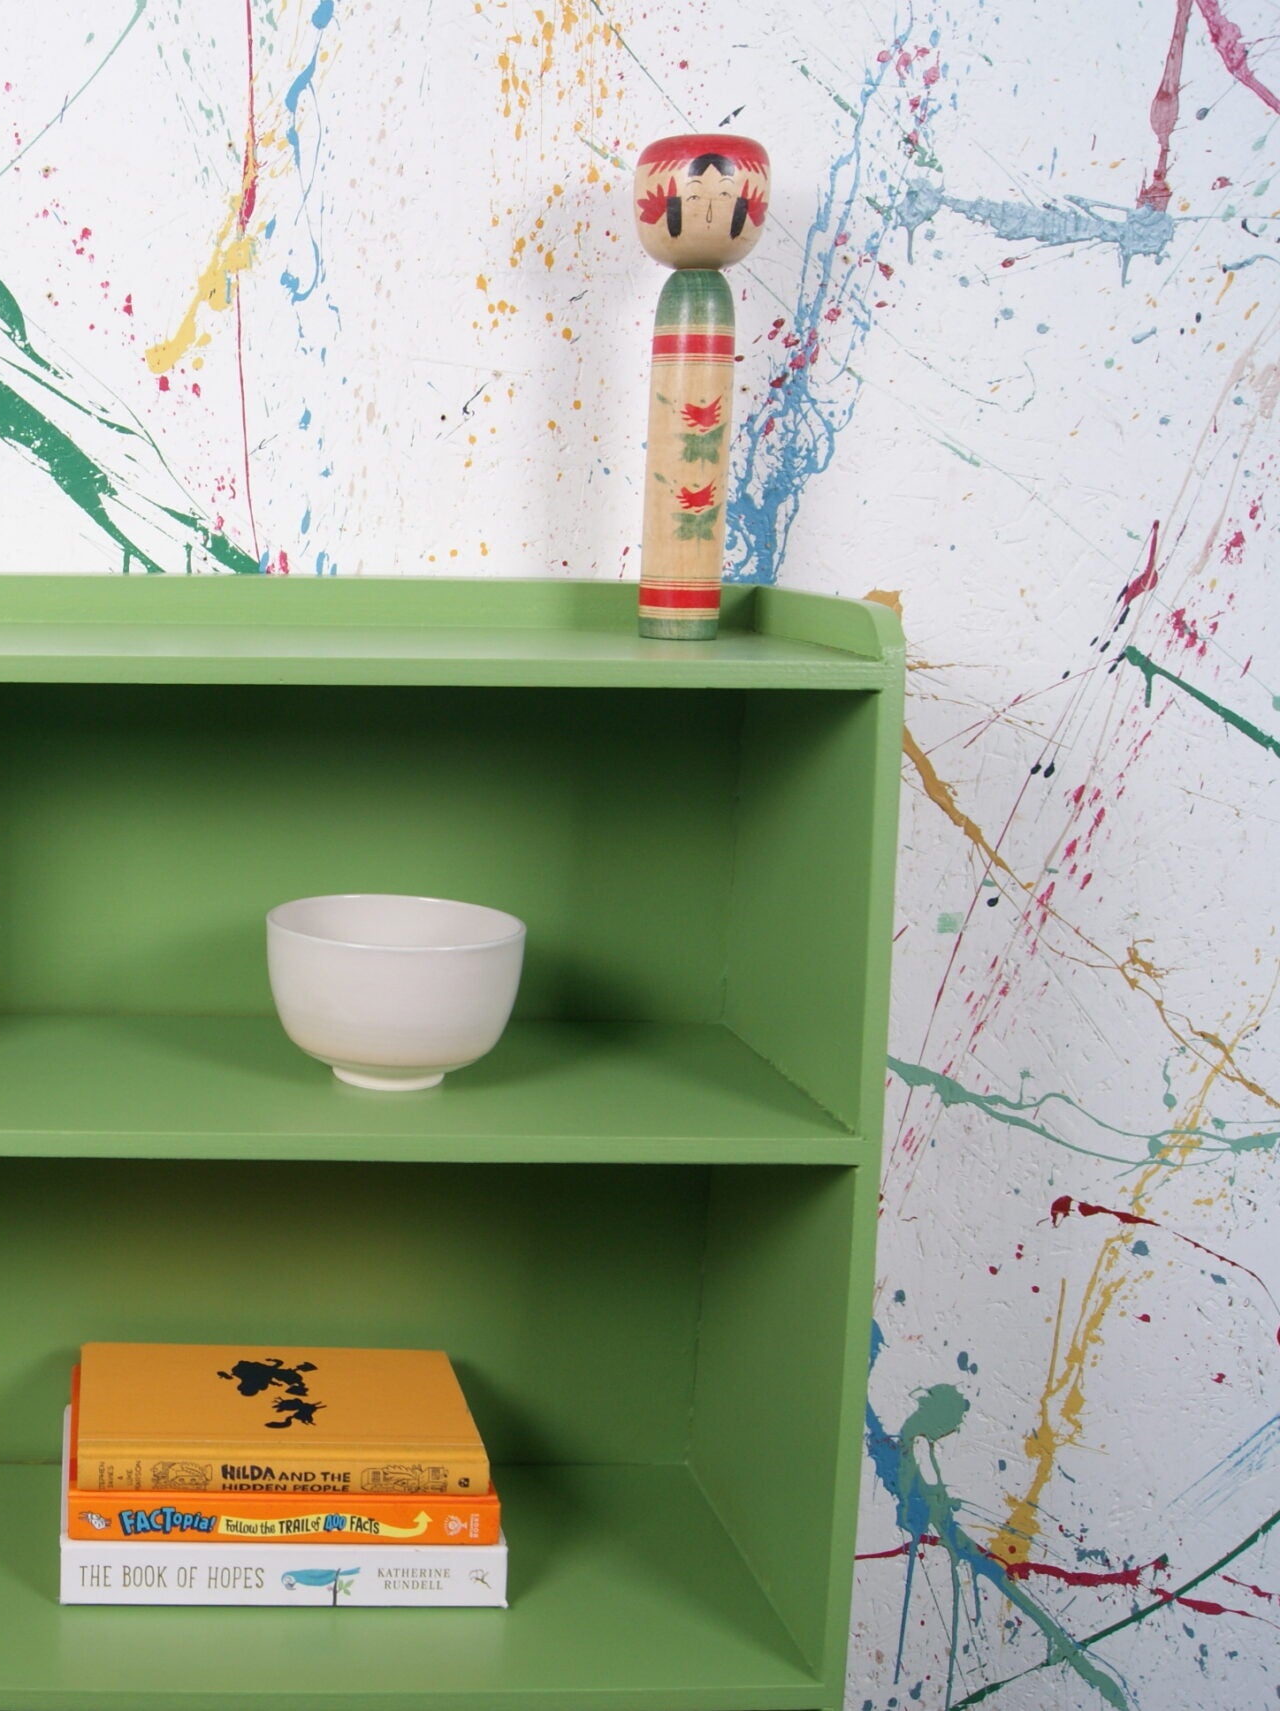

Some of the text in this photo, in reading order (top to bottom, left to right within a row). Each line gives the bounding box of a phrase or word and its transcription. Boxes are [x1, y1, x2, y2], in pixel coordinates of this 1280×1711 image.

[278, 1472, 316, 1482] AND
[320, 1472, 351, 1483] THE
[222, 1484, 350, 1493] HIDDEN PEOPLE
[226, 1518, 257, 1535] Follow
[260, 1521, 276, 1534] the
[278, 1518, 311, 1534] TRAIL
[311, 1517, 321, 1531] of
[323, 1513, 347, 1532] 400
[79, 1565, 265, 1589] THE BOOK OF HOPES
[377, 1567, 451, 1579] KATHERINE
[384, 1580, 443, 1591] RUNDELL
